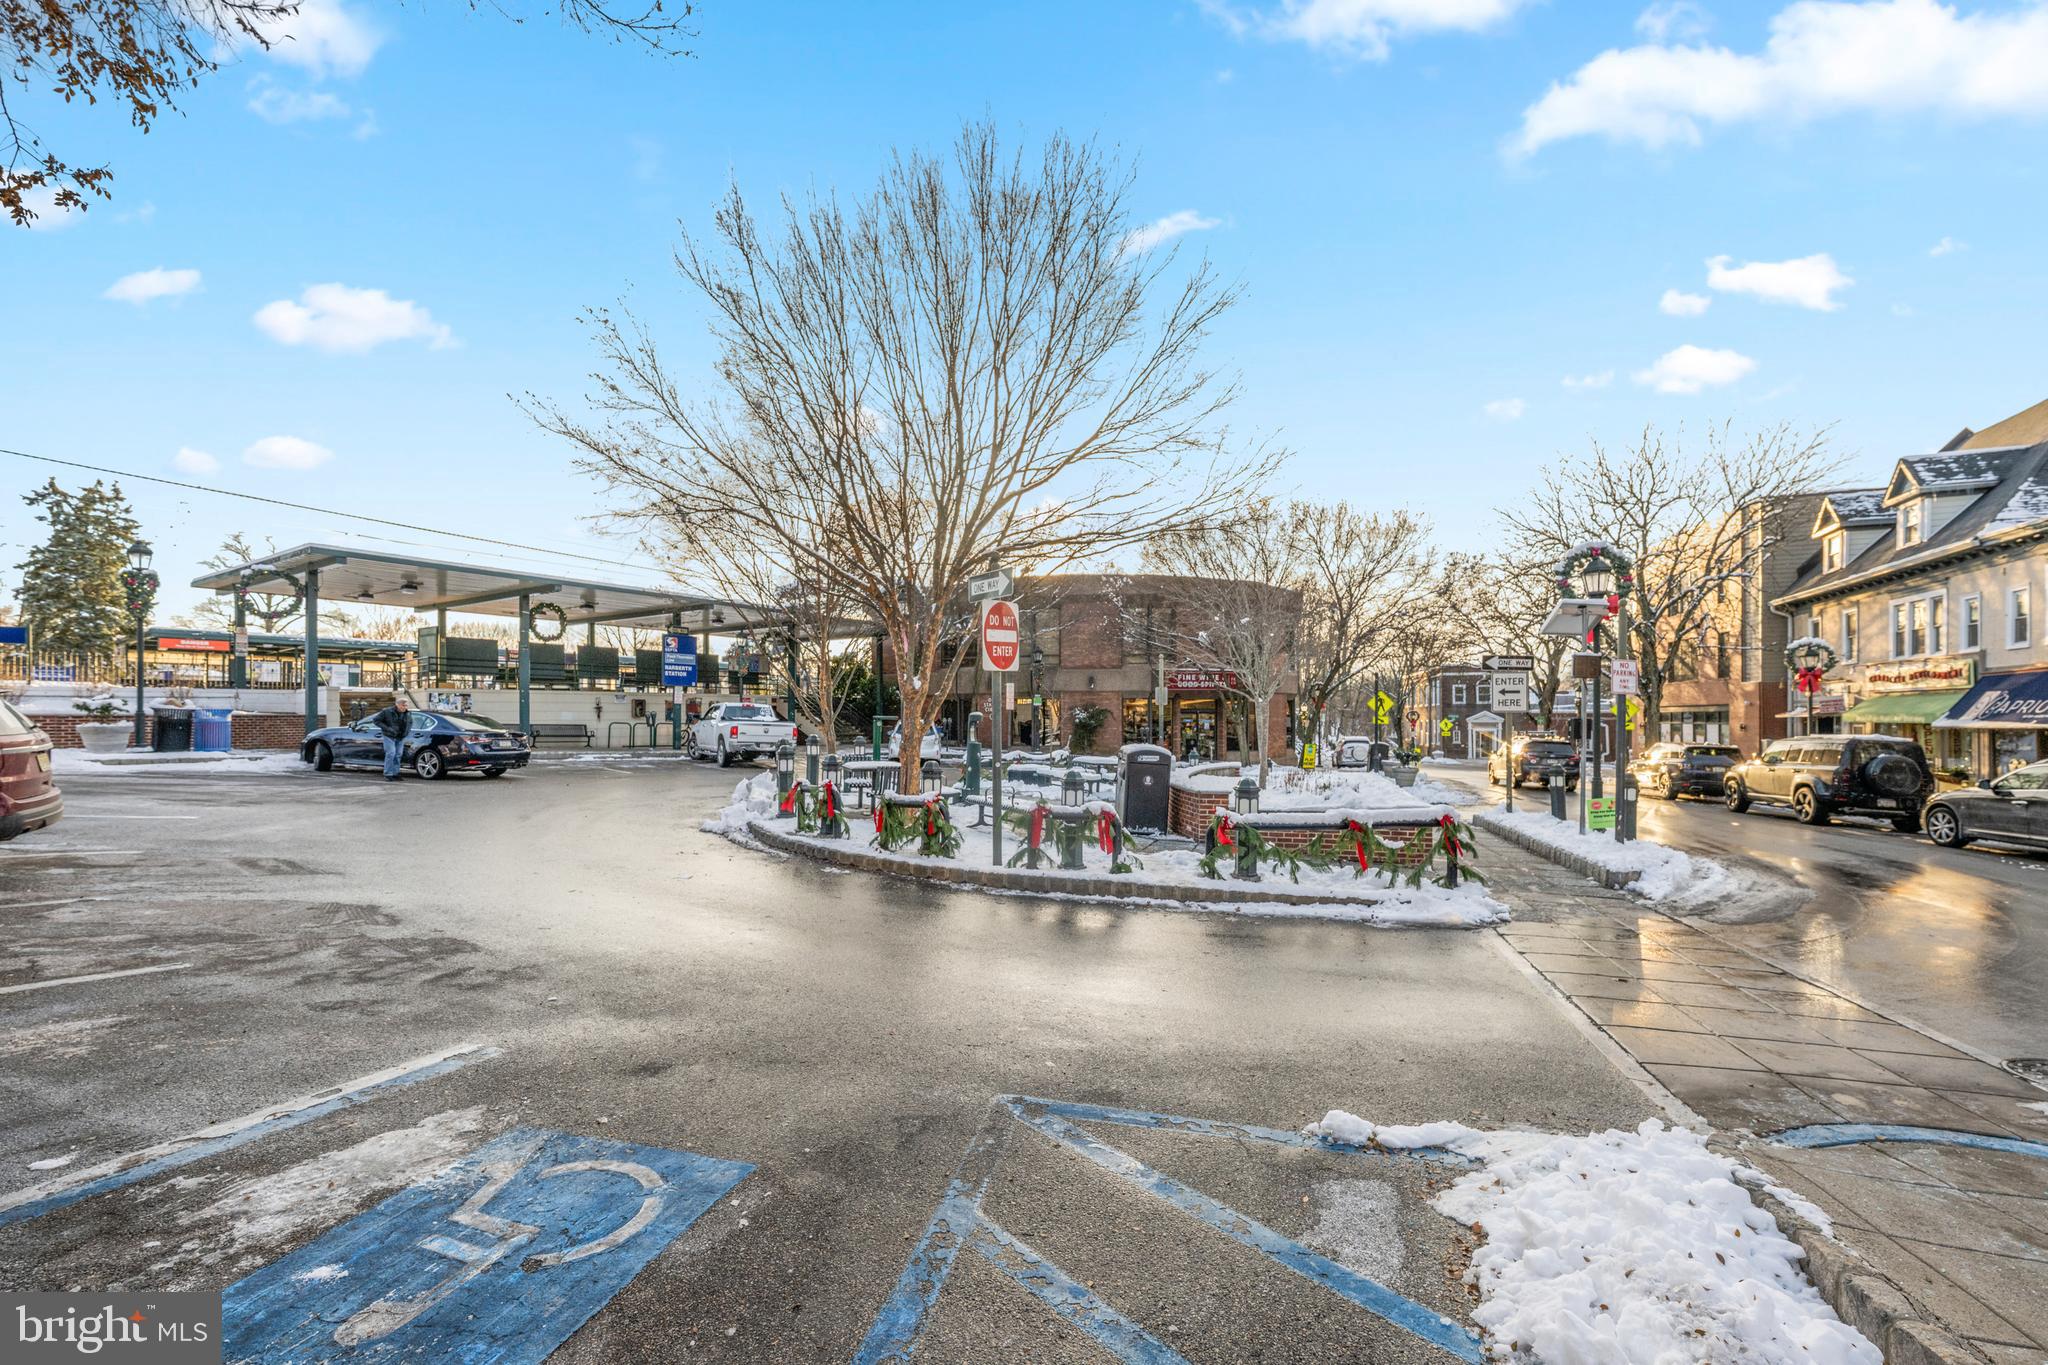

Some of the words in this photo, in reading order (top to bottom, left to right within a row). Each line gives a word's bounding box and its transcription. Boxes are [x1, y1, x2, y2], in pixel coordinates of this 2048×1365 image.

[974, 582, 985, 593] ONE
[987, 578, 999, 591] WAY
[990, 615, 999, 626] DO
[1003, 616, 1015, 627] NOT
[992, 646, 1013, 657] ENTER
[1495, 677, 1525, 686] ENTER
[1498, 698, 1522, 707] HERE
